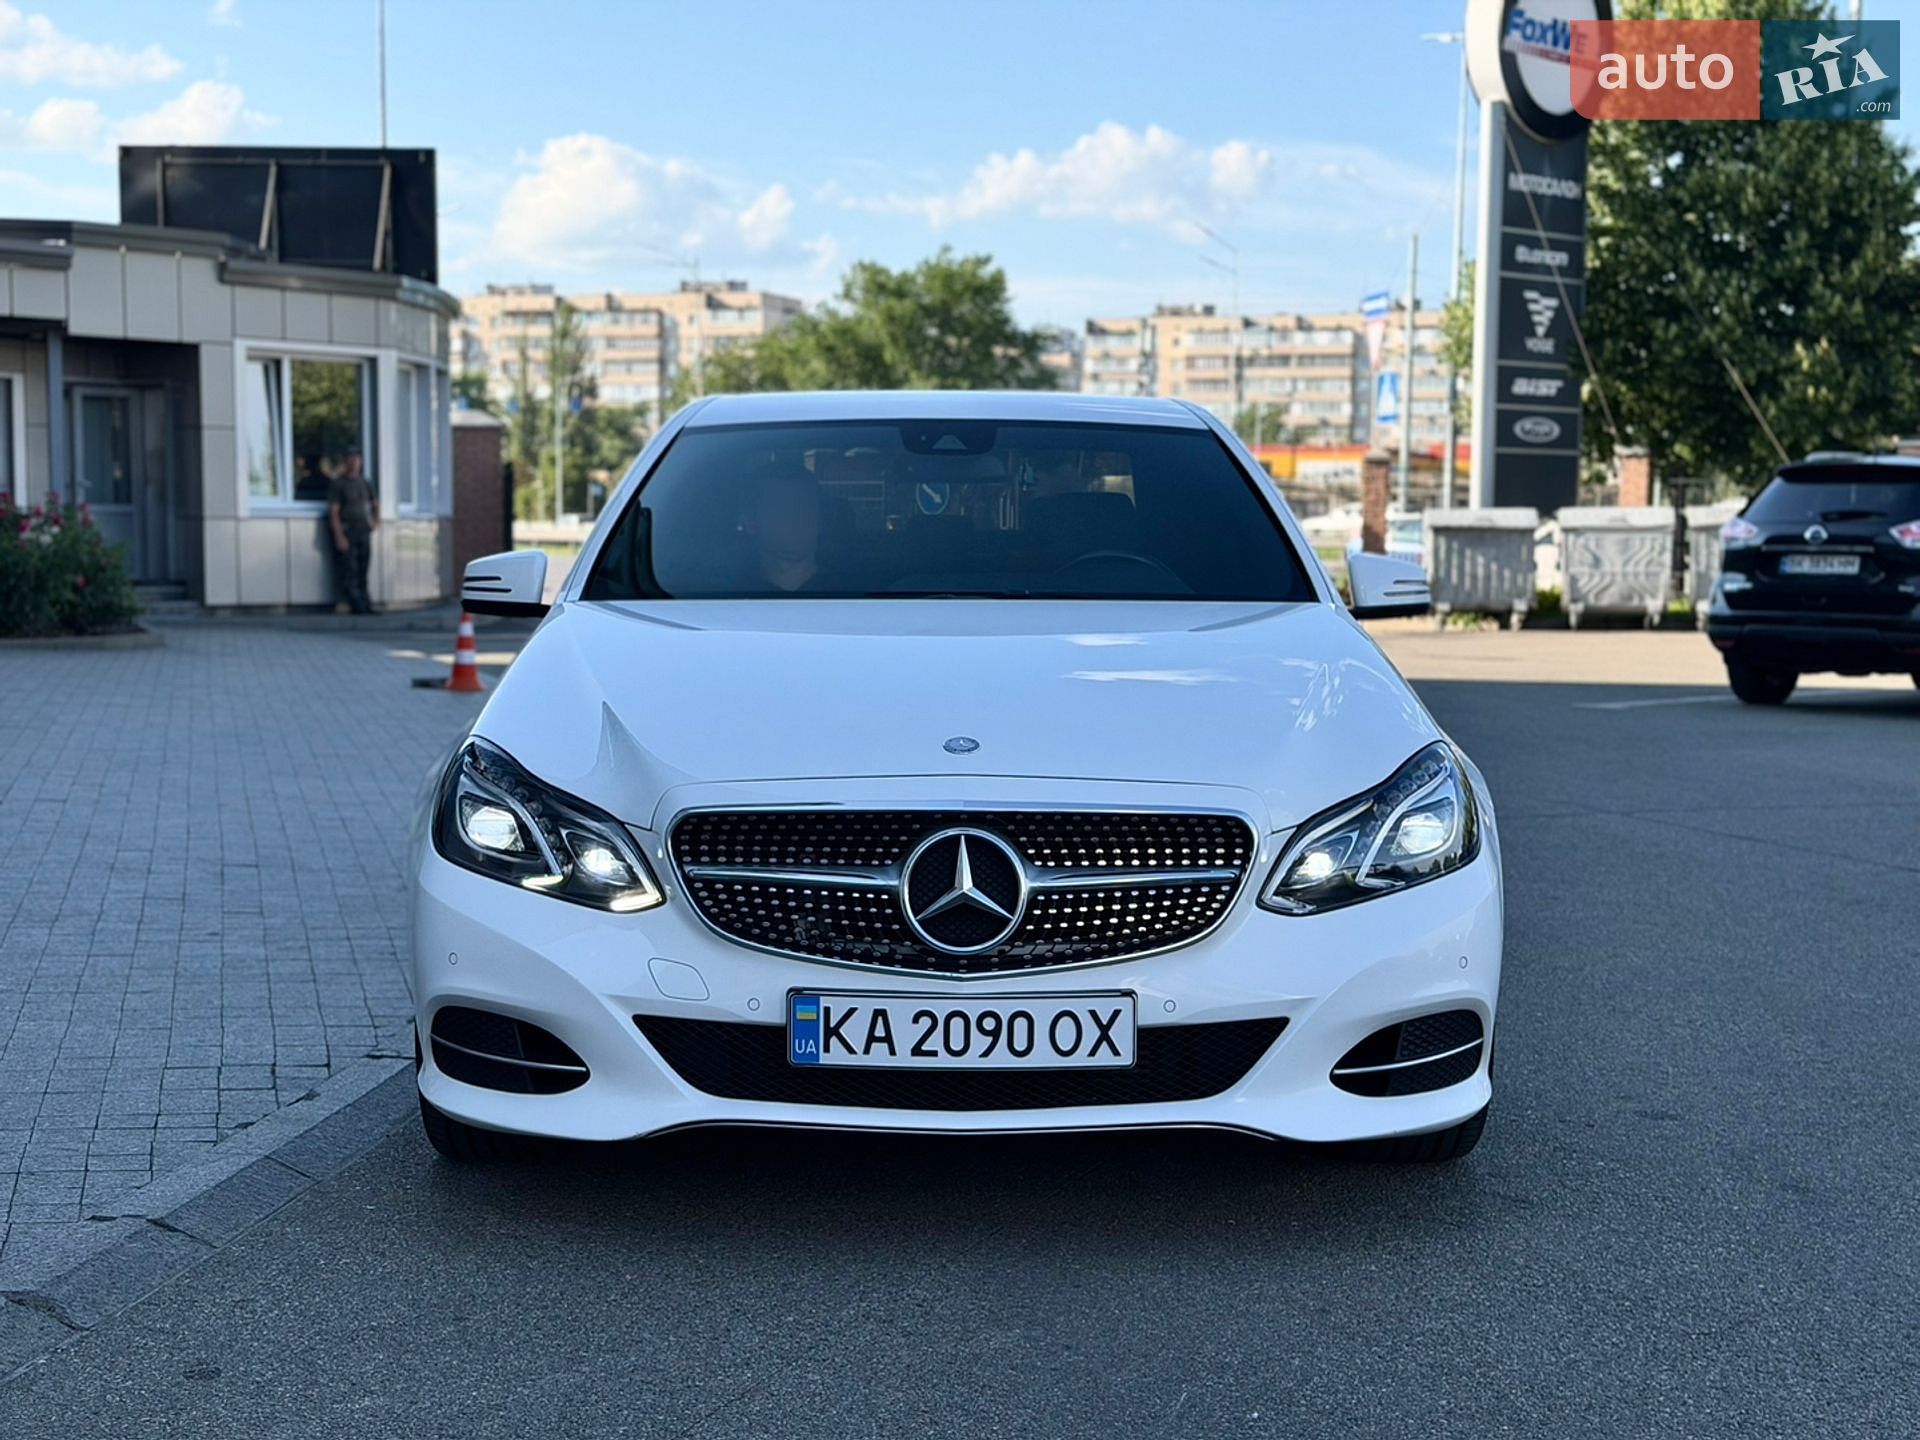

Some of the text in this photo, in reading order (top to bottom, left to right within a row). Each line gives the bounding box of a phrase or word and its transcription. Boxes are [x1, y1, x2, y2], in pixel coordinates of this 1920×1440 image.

[794, 1038, 817, 1055] UA
[822, 1005, 1123, 1058] KA 2090 OX
